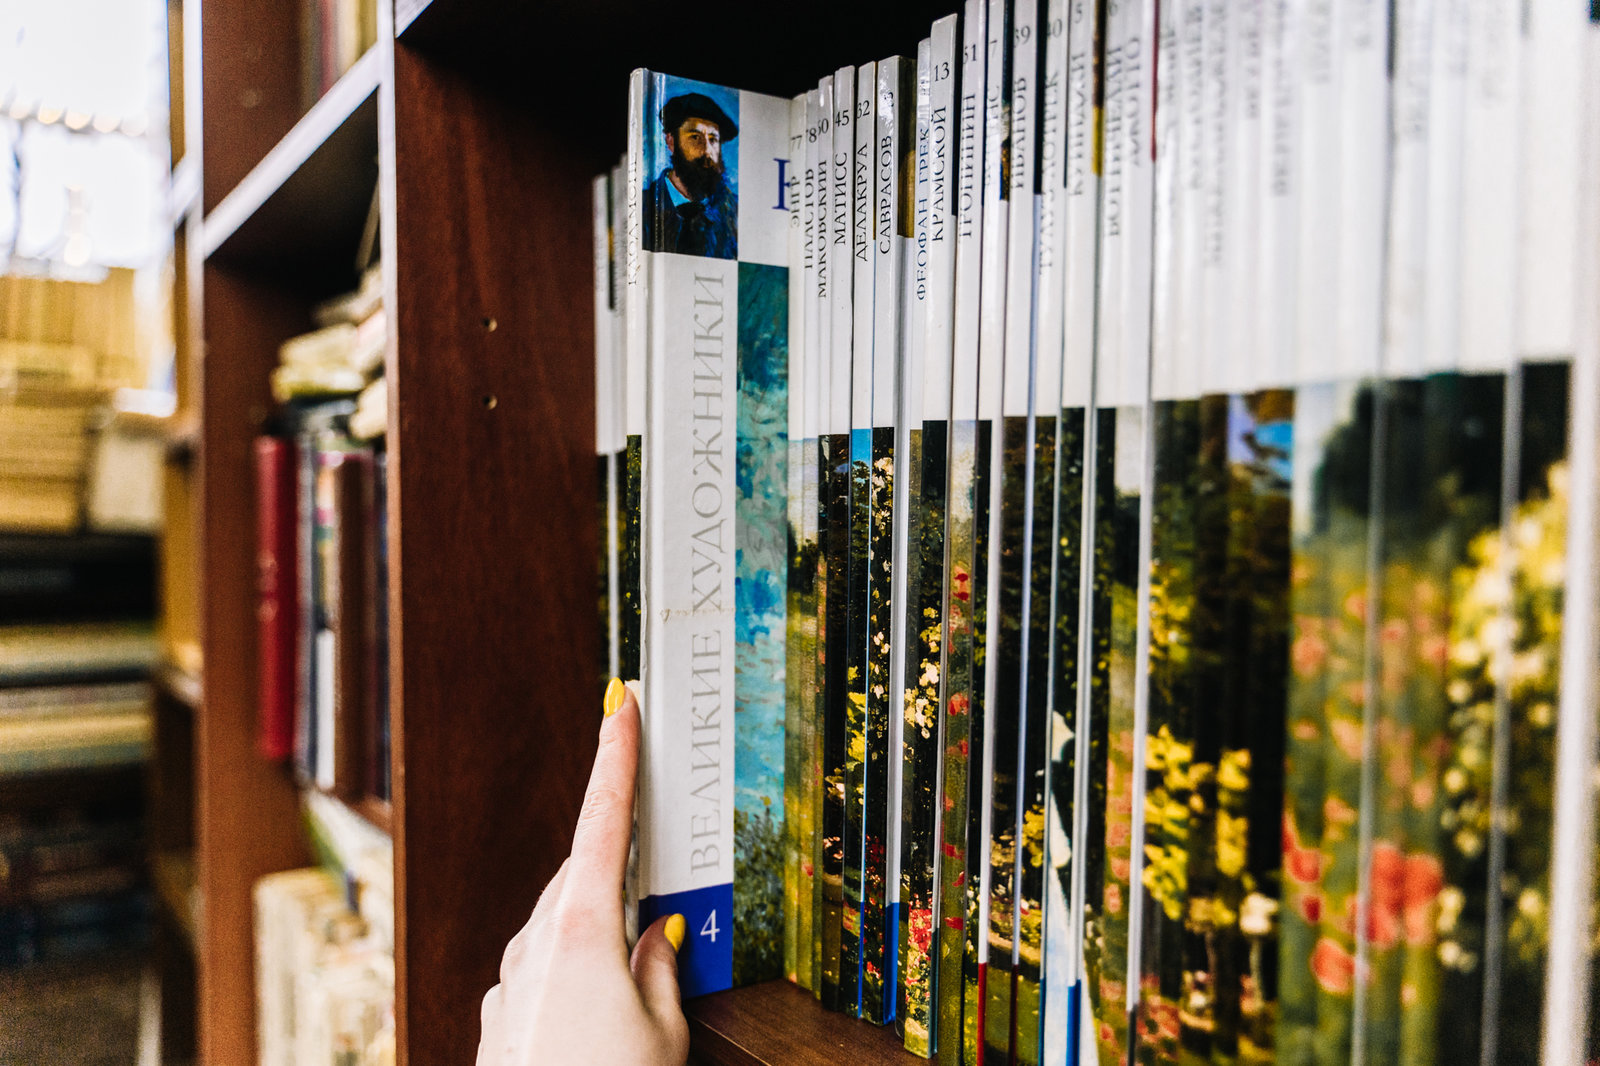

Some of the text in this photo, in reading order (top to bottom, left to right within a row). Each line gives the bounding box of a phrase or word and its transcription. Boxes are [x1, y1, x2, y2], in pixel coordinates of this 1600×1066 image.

[835, 109, 850, 127] 45
[934, 61, 950, 82] 13
[805, 127, 817, 143] 8
[930, 105, 947, 242] КРАМСКОЙ
[833, 152, 847, 246] МАТИСС
[856, 142, 869, 262] ДЕЛАКРУА
[879, 135, 892, 255] САВРАСОВ
[916, 126, 930, 301] ФЕОФАН ГРЕК
[690, 272, 725, 875] ВЕЛИКИЕ ХУДОЖНИКИ
[699, 908, 721, 943] 4
